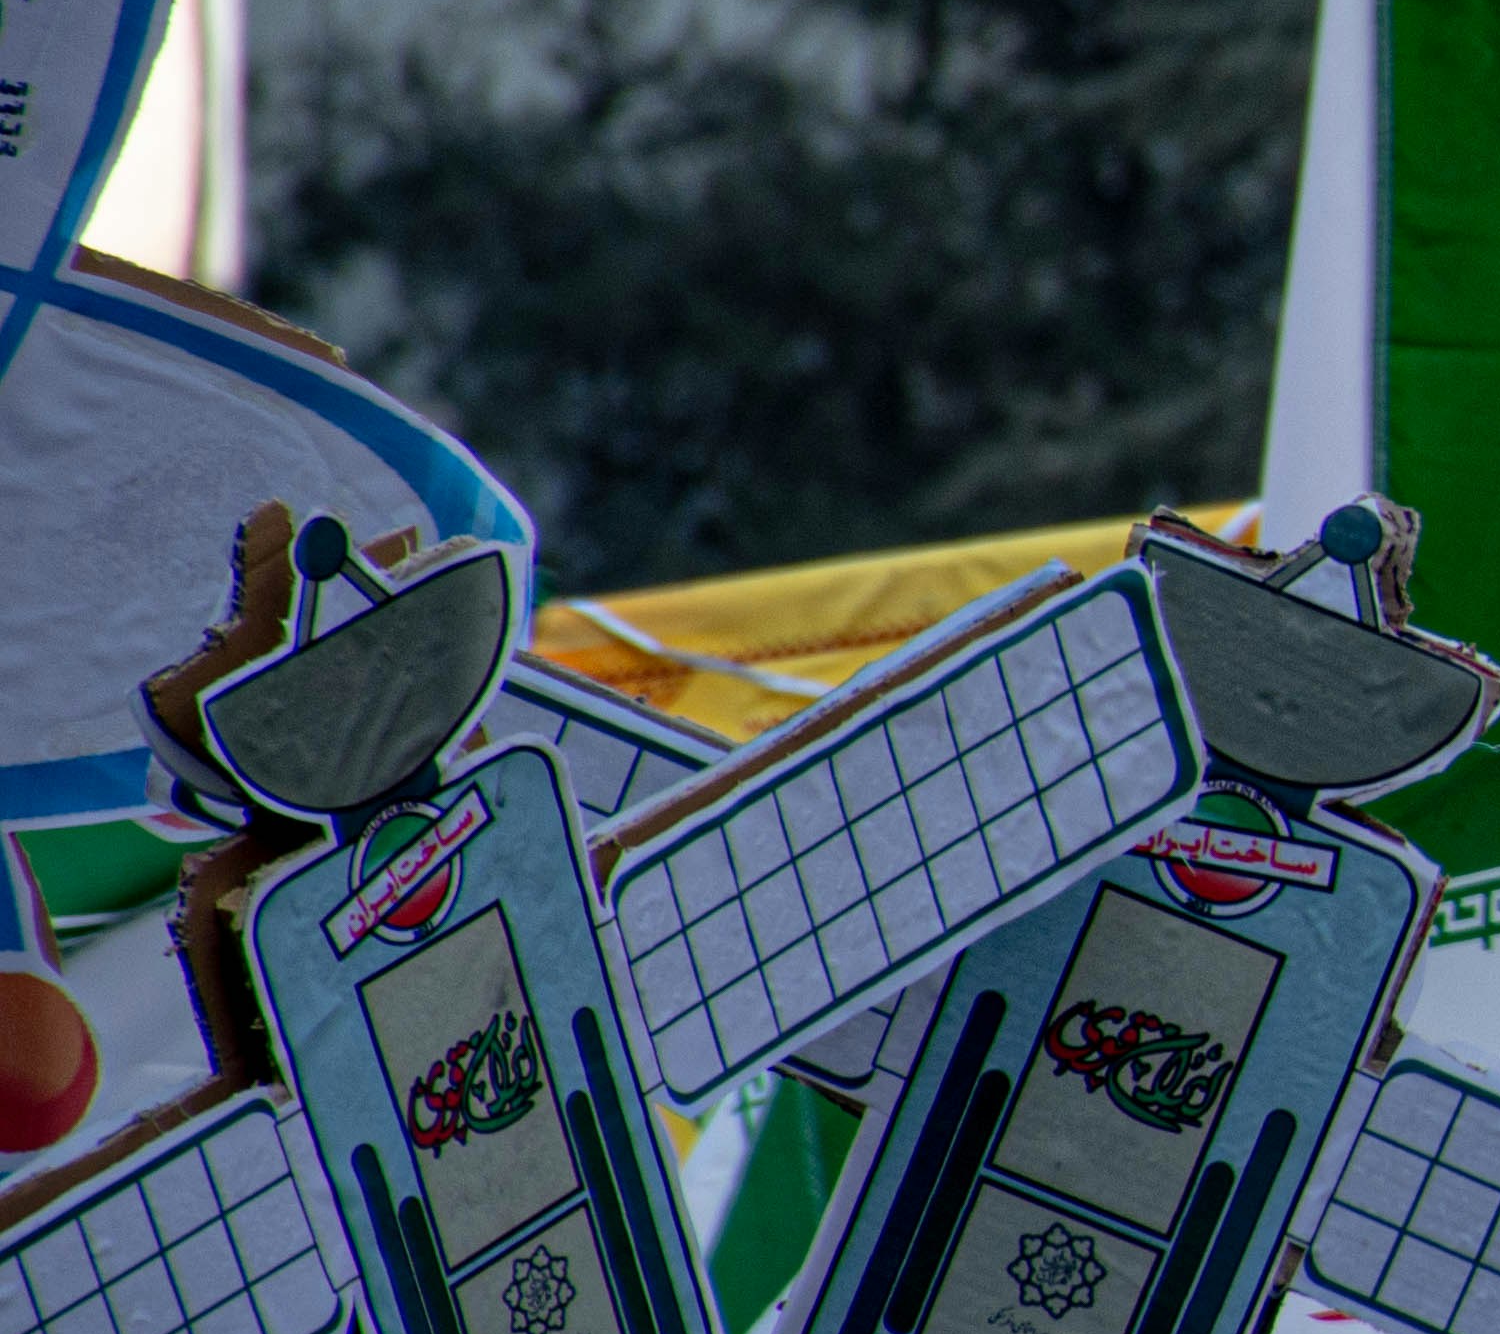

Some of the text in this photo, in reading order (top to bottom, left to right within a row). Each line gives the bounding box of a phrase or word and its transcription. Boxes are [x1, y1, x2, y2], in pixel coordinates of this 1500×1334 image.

[396, 810, 475, 886] ساخت
[1210, 837, 1318, 876] ساخت
[348, 866, 401, 941] ایران
